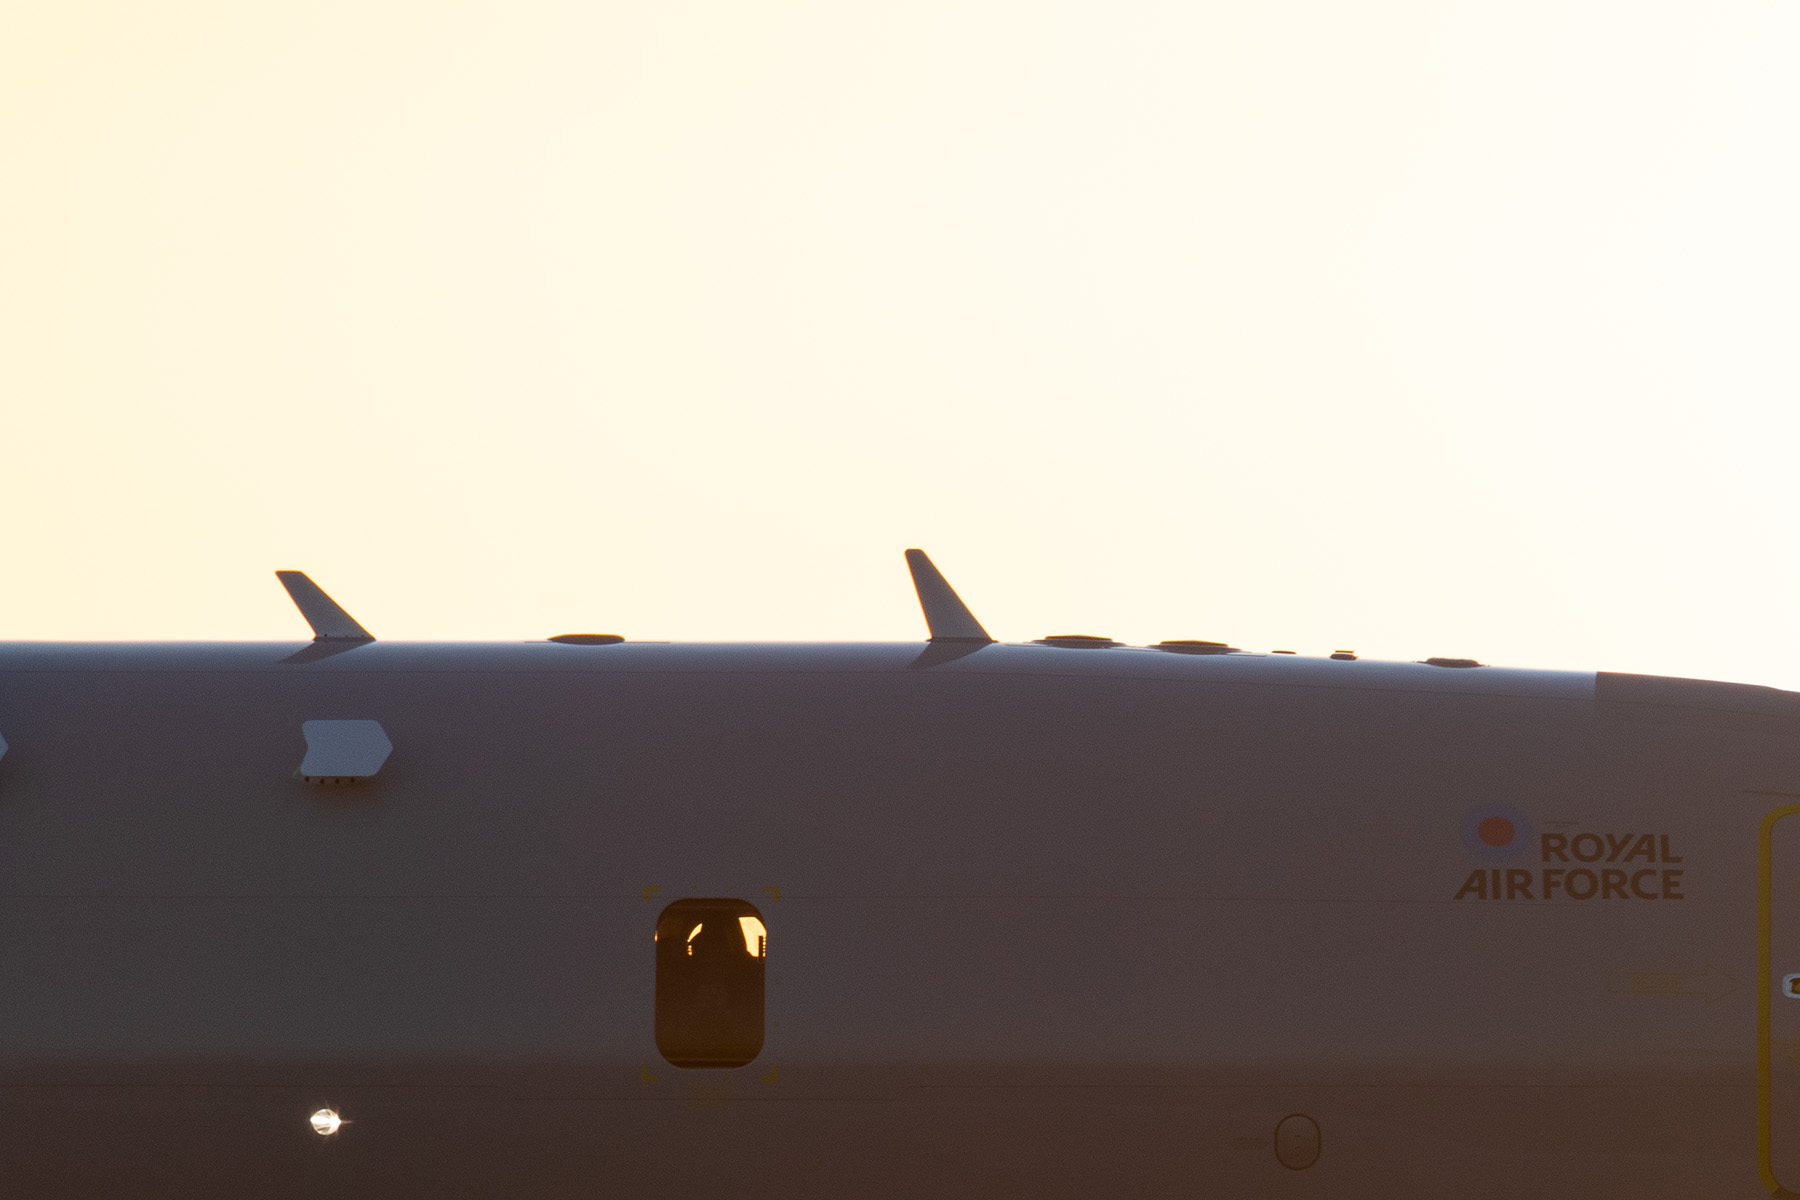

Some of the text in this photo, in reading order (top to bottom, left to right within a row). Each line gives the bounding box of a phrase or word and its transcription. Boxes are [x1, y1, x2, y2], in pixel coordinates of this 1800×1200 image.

[1541, 833, 1683, 863] ROYAL
[1453, 868, 1684, 900] AIR FORCE
